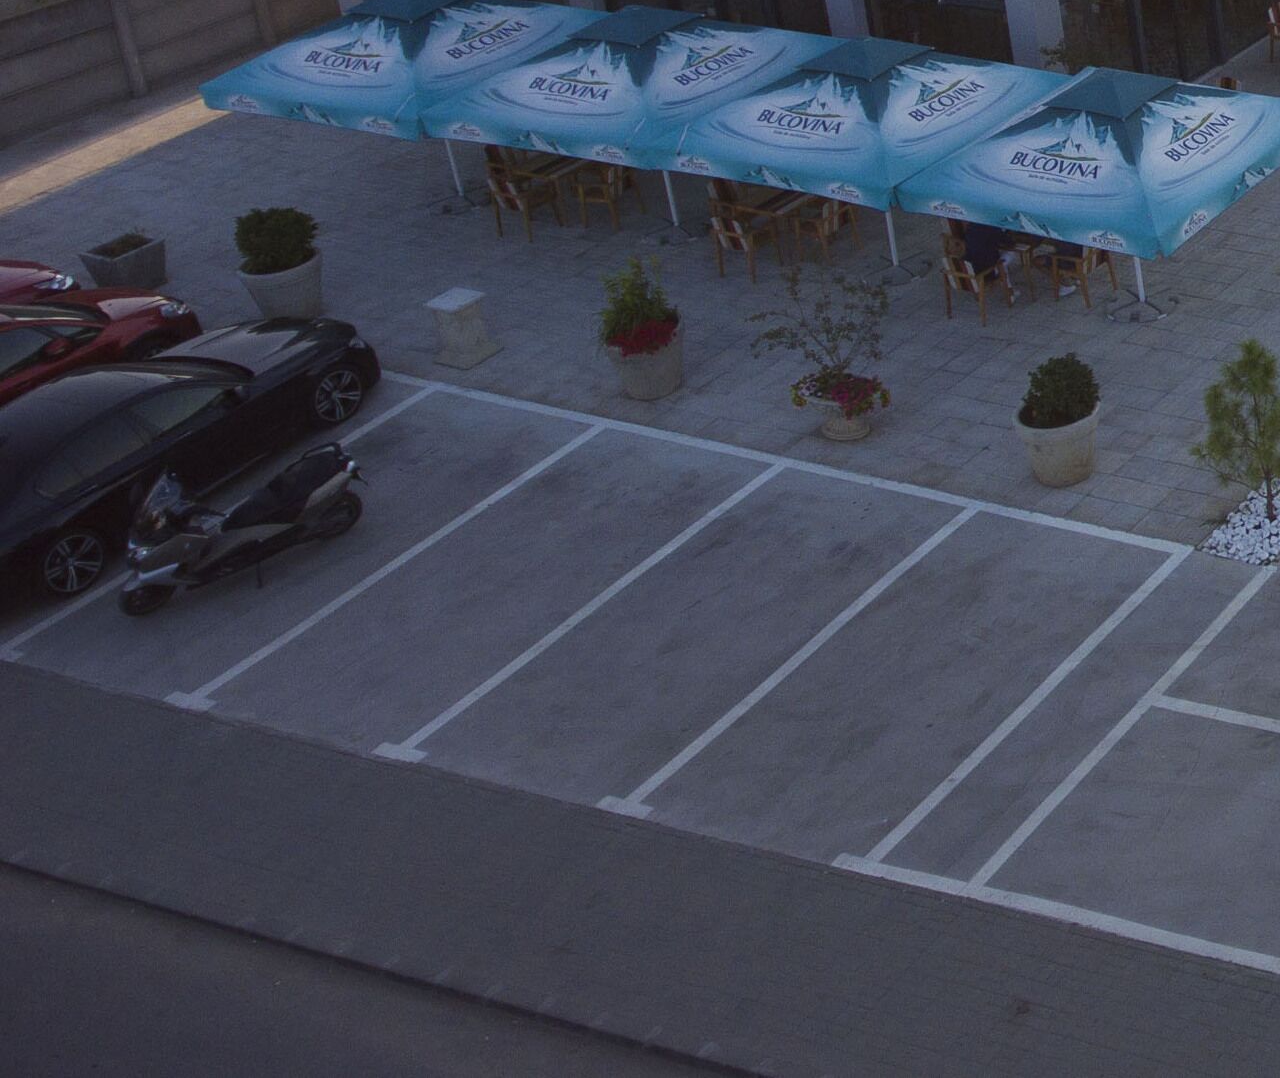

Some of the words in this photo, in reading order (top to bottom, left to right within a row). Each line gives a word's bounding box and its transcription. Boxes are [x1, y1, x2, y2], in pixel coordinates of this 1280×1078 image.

[446, 20, 530, 59] BUCOVINA
[304, 50, 382, 73] BUCOVINA
[674, 47, 754, 86] BUCOVINA
[529, 77, 610, 101] BUCOVINA
[908, 81, 985, 122] BUCOVINA
[757, 109, 842, 134] BUCOVINA
[1164, 113, 1236, 162] BUCOVINA
[1010, 151, 1099, 179] BUCOVINA
